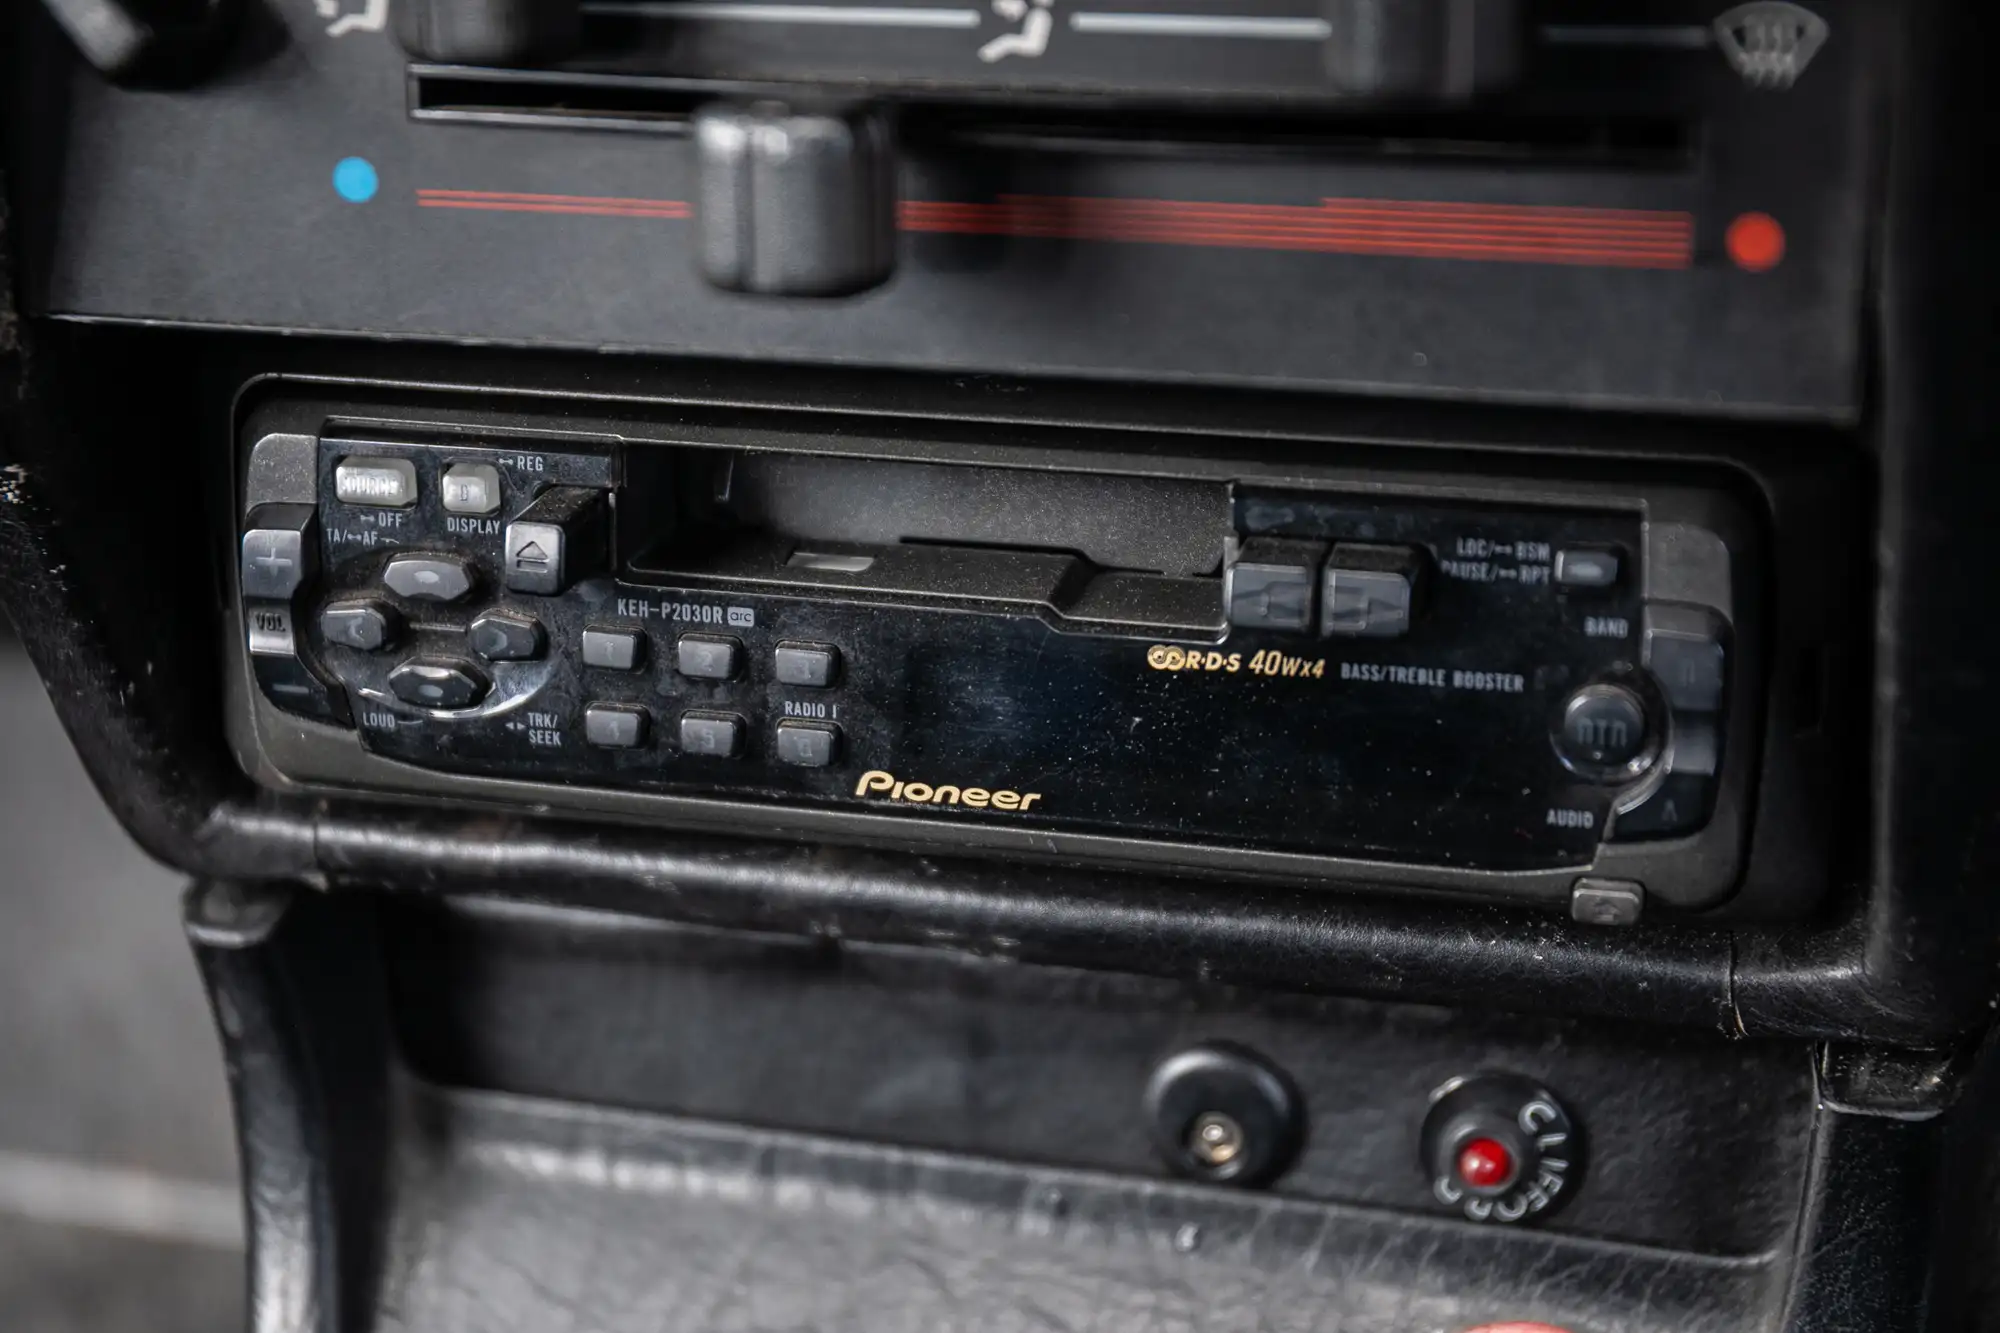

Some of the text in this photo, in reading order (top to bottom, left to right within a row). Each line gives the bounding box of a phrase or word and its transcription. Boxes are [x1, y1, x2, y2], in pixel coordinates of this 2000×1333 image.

[517, 455, 544, 472] REG
[378, 512, 403, 528] OFF
[447, 517, 500, 534] DISPLAY
[362, 531, 378, 546] AF
[617, 598, 723, 624] KEH-P2030R
[255, 612, 286, 632] VOL
[1584, 616, 1629, 639] BAND
[1340, 662, 1525, 692] BASS/TREBLE BOOSTER
[785, 701, 826, 718] RADIO
[363, 712, 395, 728] LOUD
[528, 712, 558, 728] TRK/
[528, 728, 561, 746] SEEK
[855, 770, 1042, 811] Pioneer
[1547, 808, 1594, 828] AUDIO
